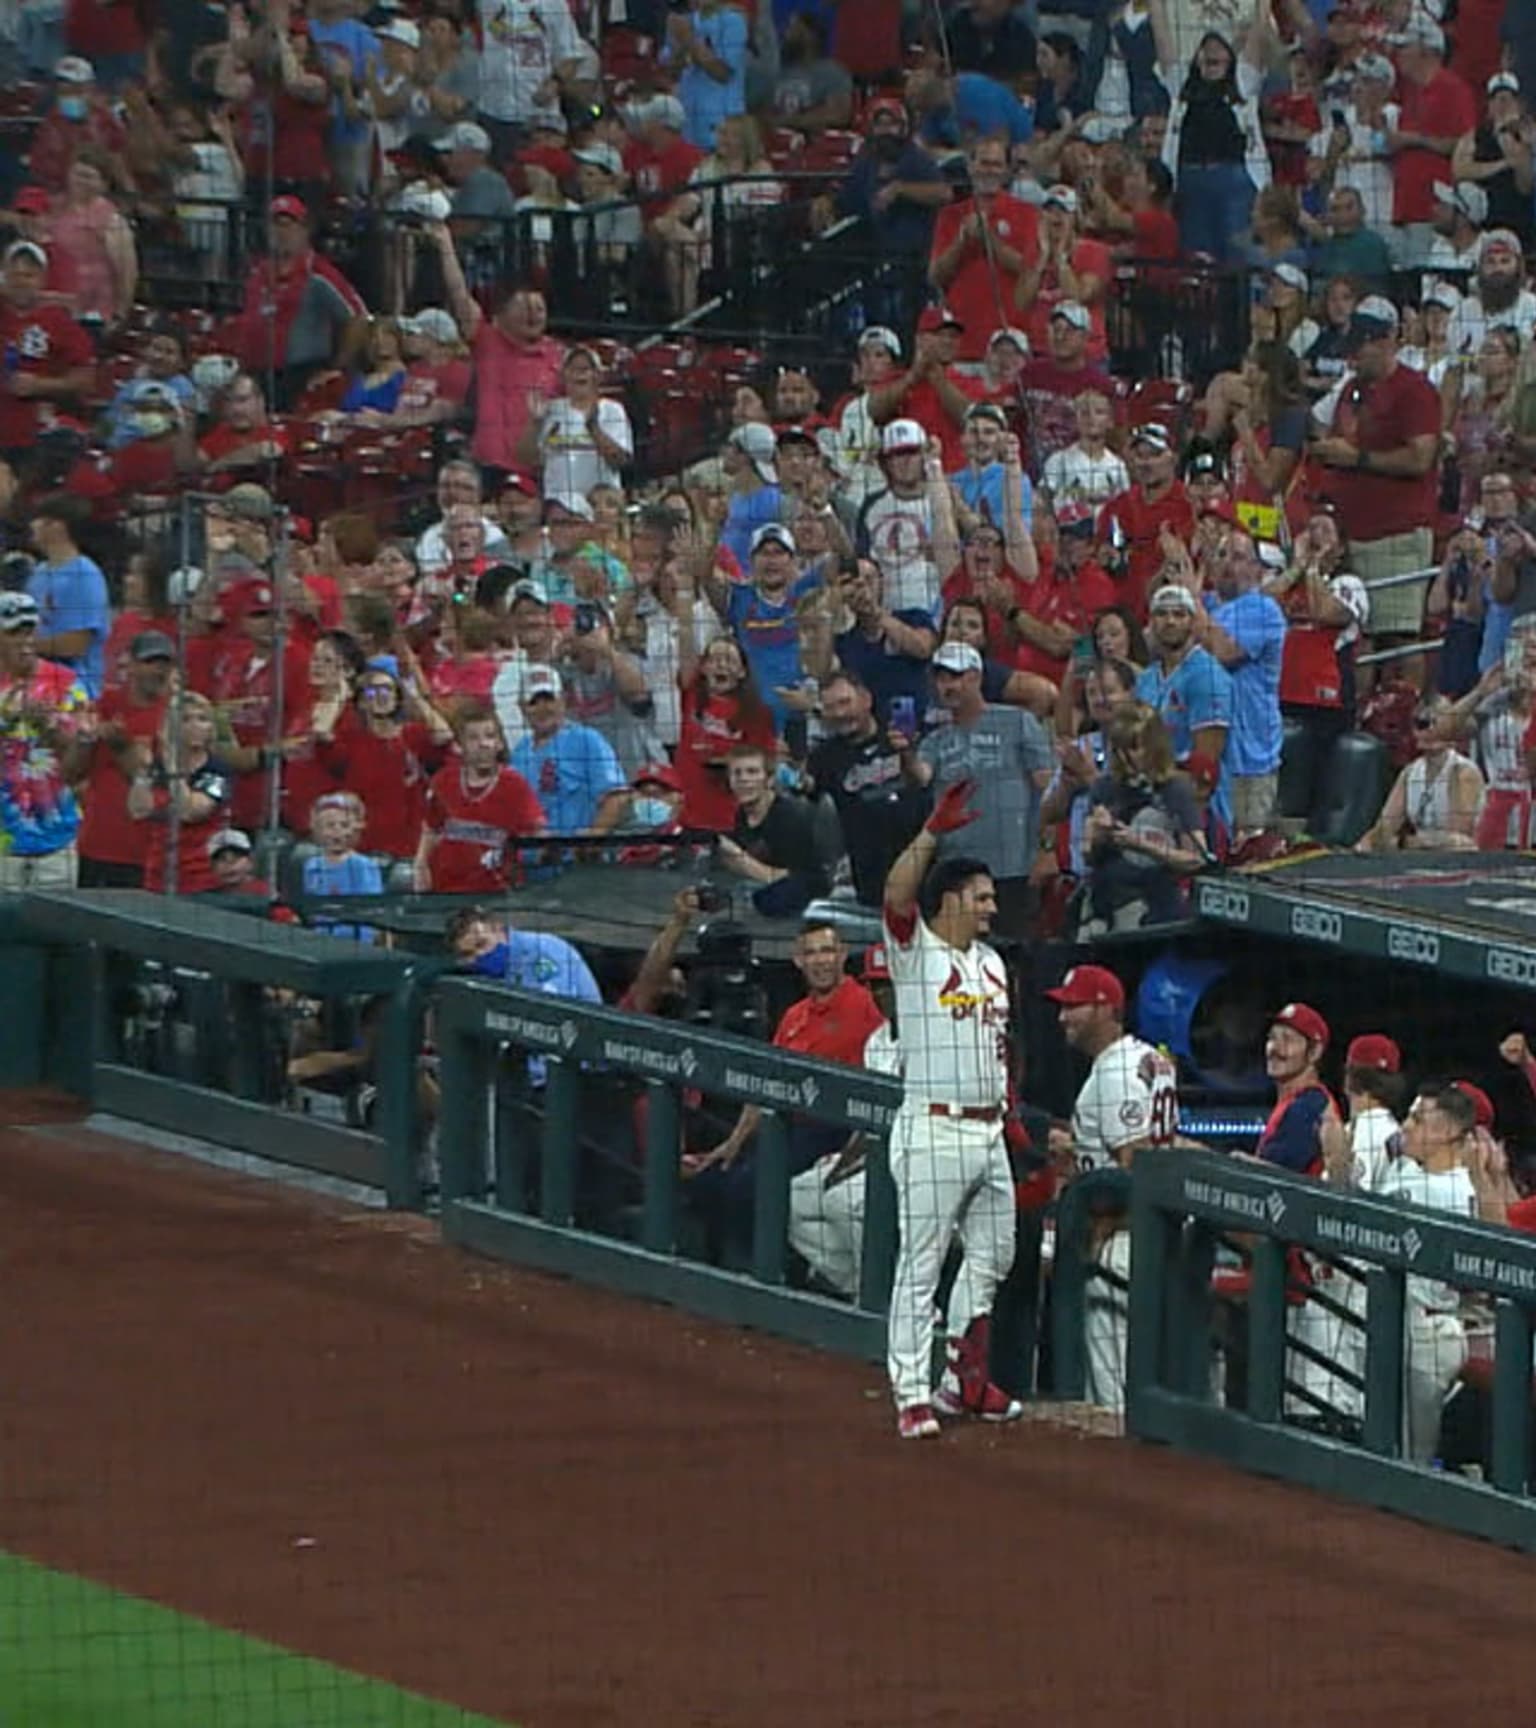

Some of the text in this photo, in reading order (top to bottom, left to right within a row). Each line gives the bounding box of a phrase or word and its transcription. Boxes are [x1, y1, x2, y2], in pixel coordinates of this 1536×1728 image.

[1201, 886, 1249, 920] GEICO
[1293, 905, 1342, 941] GEICO
[1389, 928, 1438, 964] GEICO
[1454, 1251, 1481, 1277] BANK
[1484, 1259, 1495, 1279] OF
